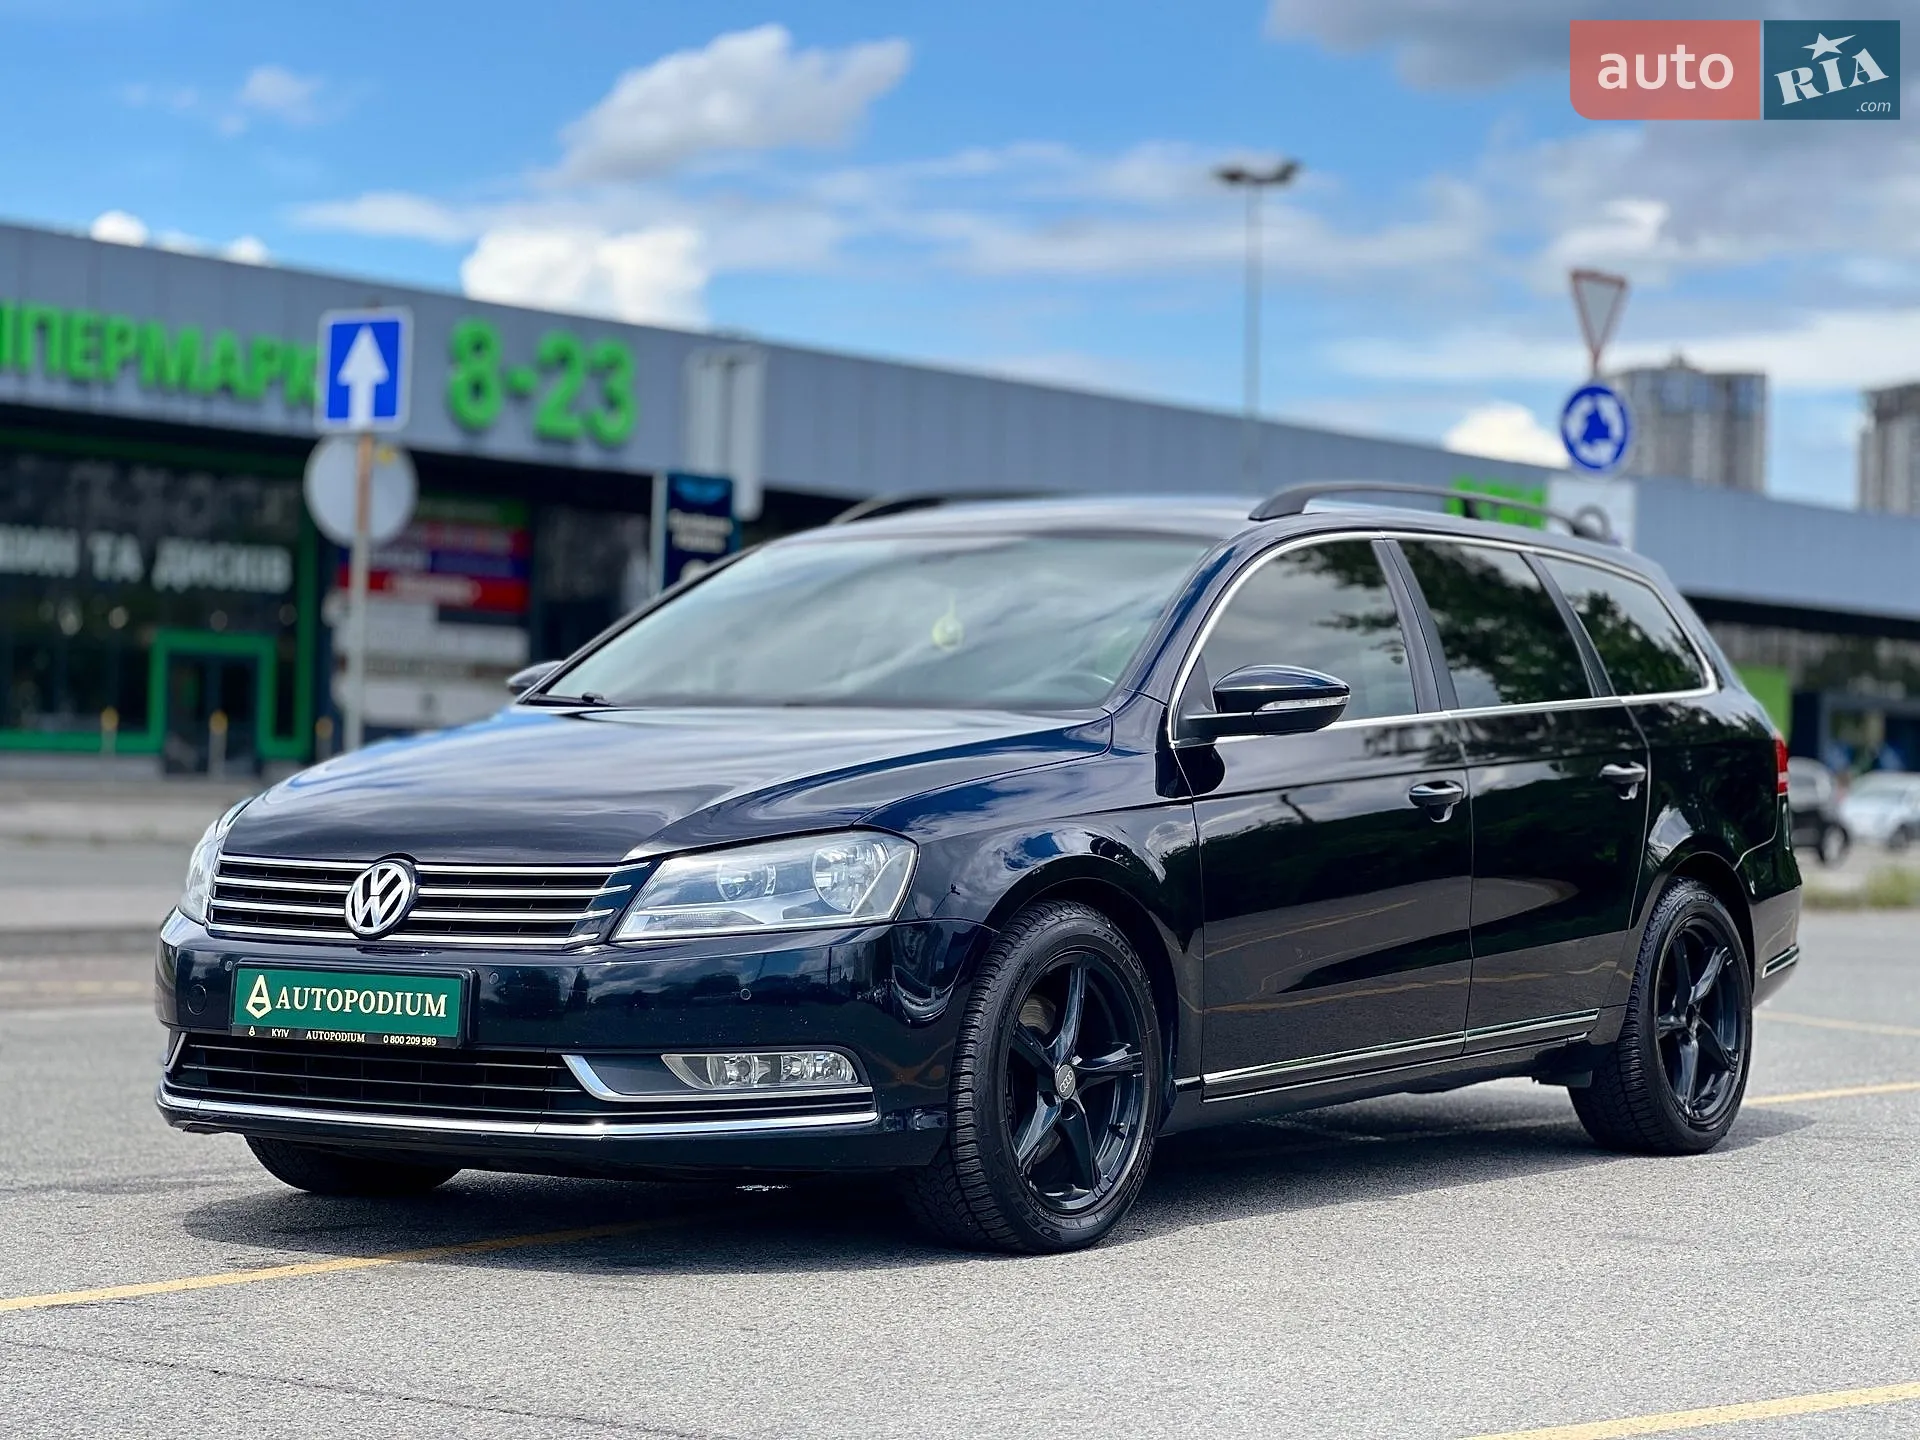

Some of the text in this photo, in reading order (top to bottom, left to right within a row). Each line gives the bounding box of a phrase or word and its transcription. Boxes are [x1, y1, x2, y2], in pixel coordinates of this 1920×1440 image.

[447, 318, 637, 443] 8-23
[347, 863, 409, 933] VW
[275, 986, 448, 1018] AUTOPODIUM
[271, 1028, 290, 1038] KYIV
[306, 1030, 366, 1043] AUTOPODIUM
[390, 1035, 405, 1045] 800
[406, 1036, 420, 1046] 209
[421, 1037, 437, 1047] 989
